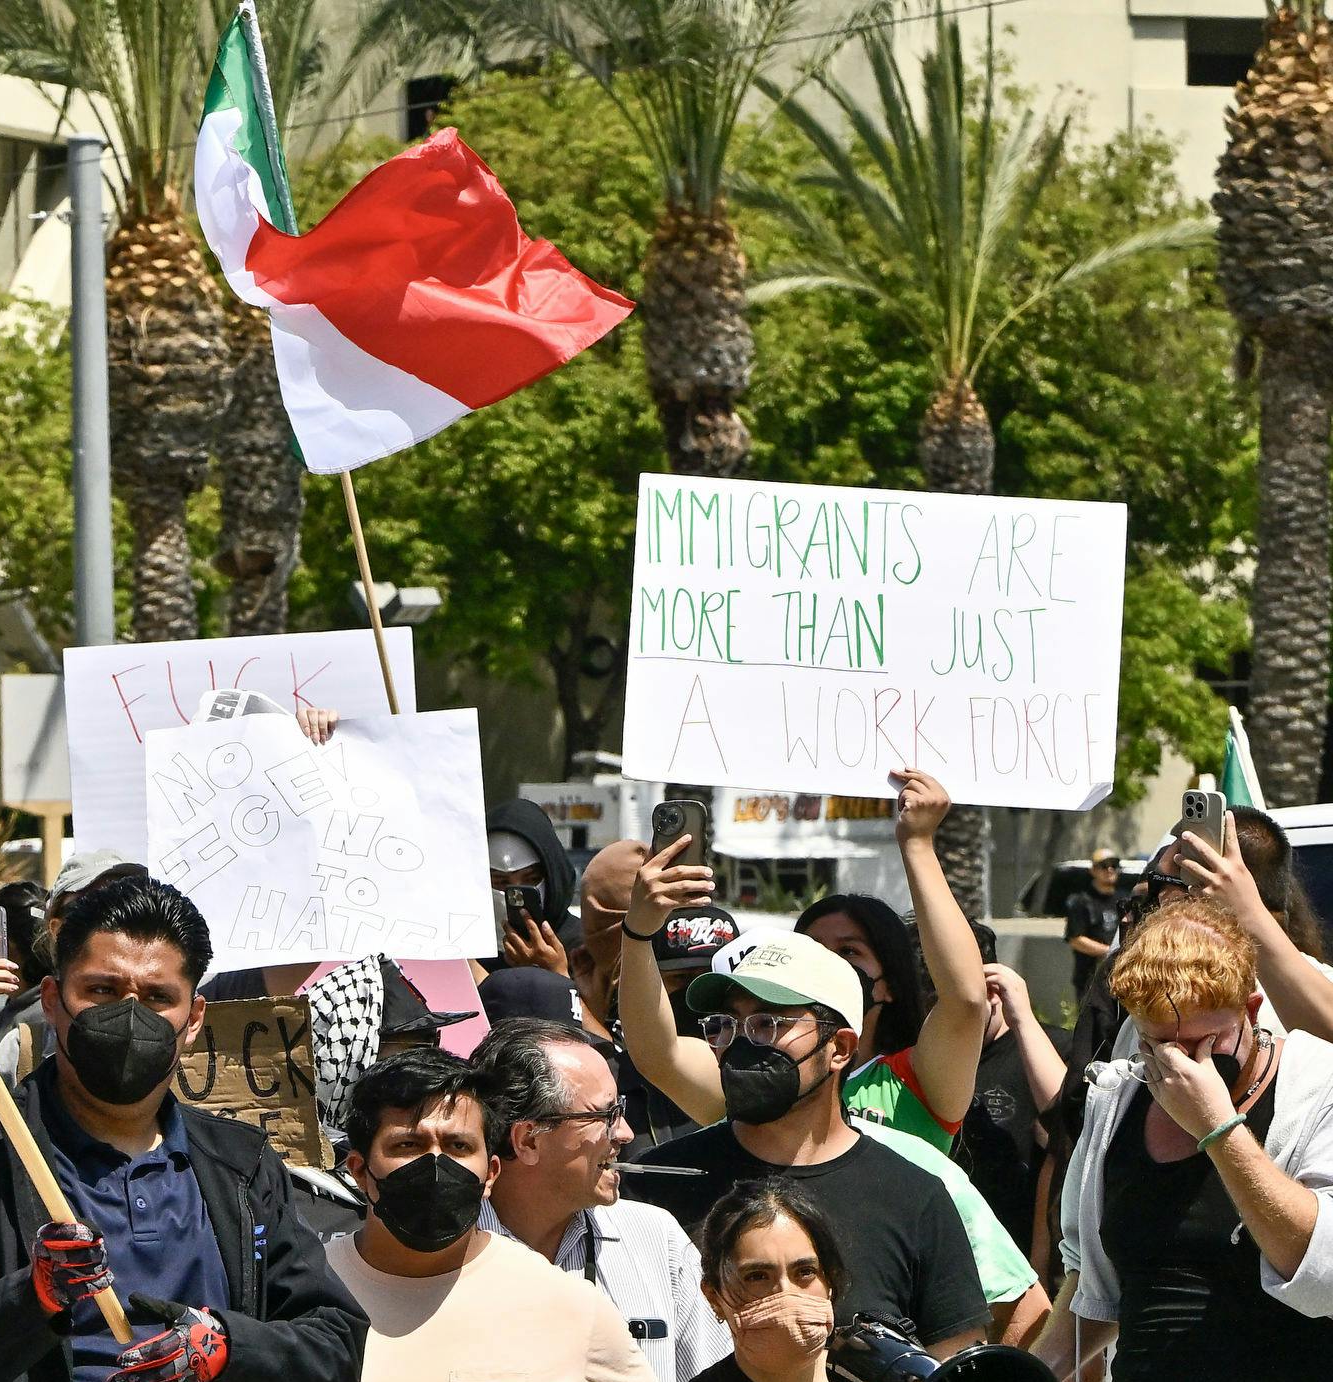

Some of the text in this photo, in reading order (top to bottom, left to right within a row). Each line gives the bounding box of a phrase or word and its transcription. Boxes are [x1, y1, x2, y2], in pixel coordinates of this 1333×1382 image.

[645, 486, 1083, 603] IMMIGRANTS ARE
[639, 587, 1048, 684] MORE THAN JUST
[668, 673, 1102, 786] A WORK FORCE
[152, 741, 253, 825] NO
[323, 810, 424, 872] NO
[228, 885, 481, 957] HATE!
[310, 863, 379, 906] TO
